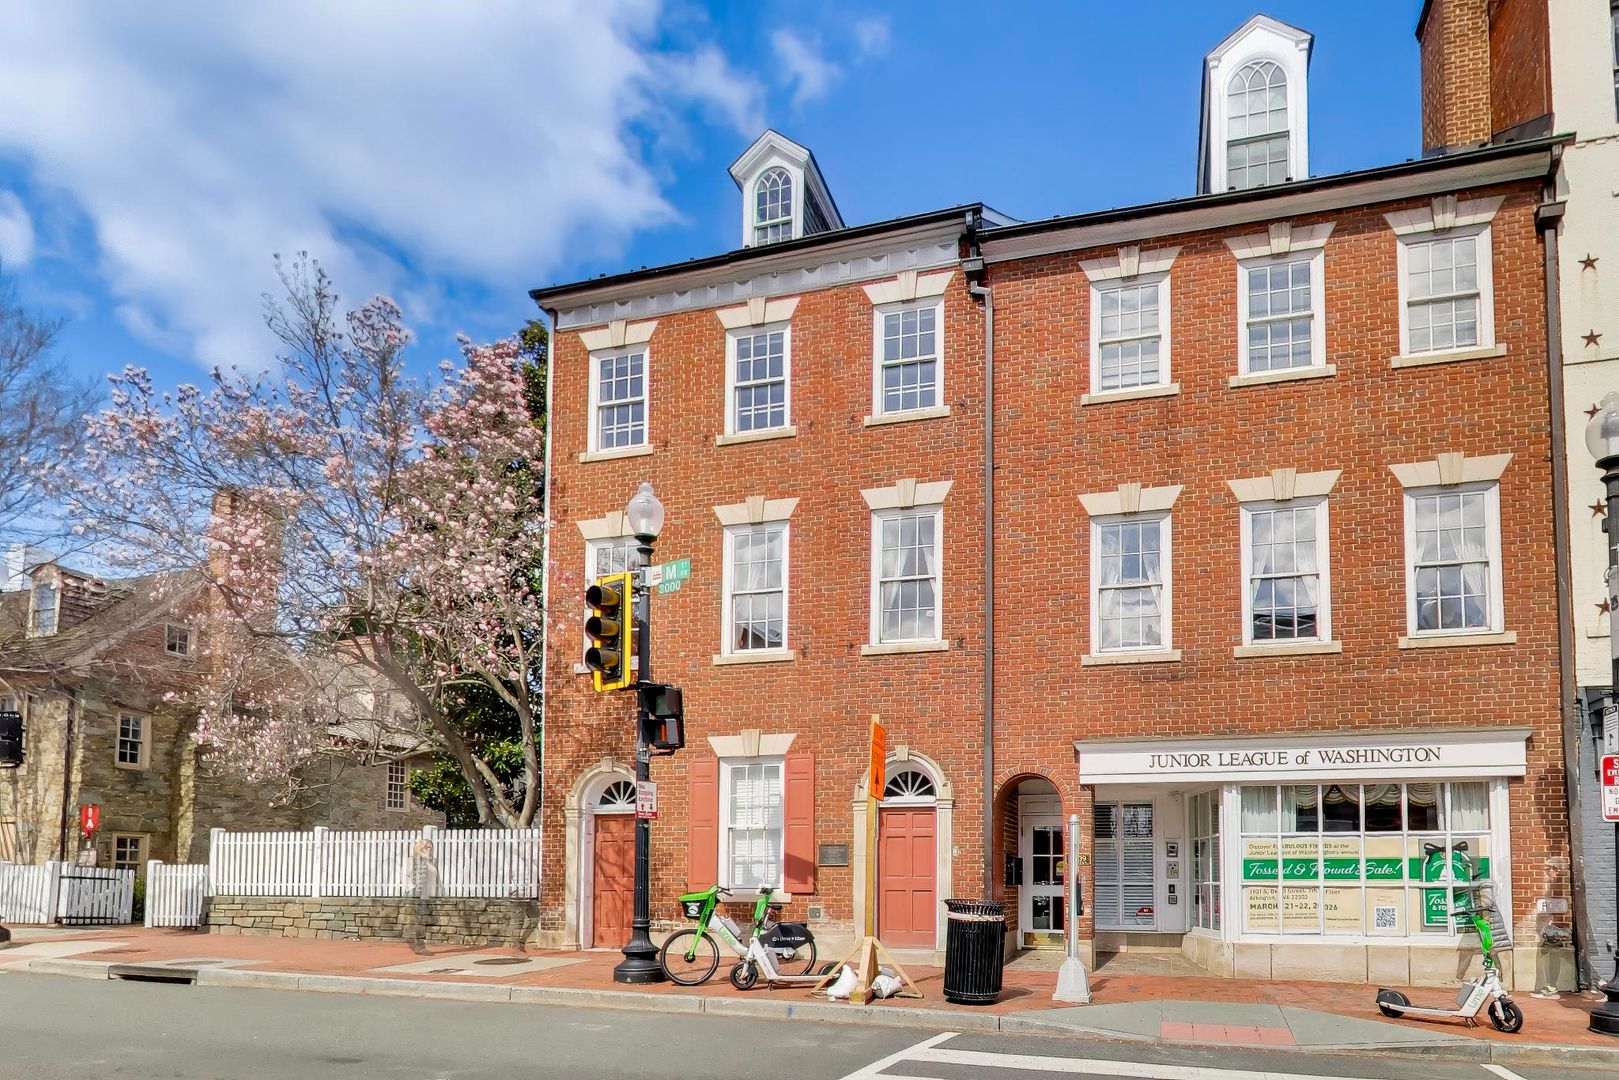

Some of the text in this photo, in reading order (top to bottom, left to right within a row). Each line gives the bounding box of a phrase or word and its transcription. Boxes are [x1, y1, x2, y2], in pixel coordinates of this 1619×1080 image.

[666, 564, 677, 580] M
[658, 581, 681, 594] 3000
[1149, 747, 1441, 768] JUNIOR LEAGUE of WASHINGTON
[1294, 863, 1306, 875] &
[1467, 988, 1484, 1009] Lime
